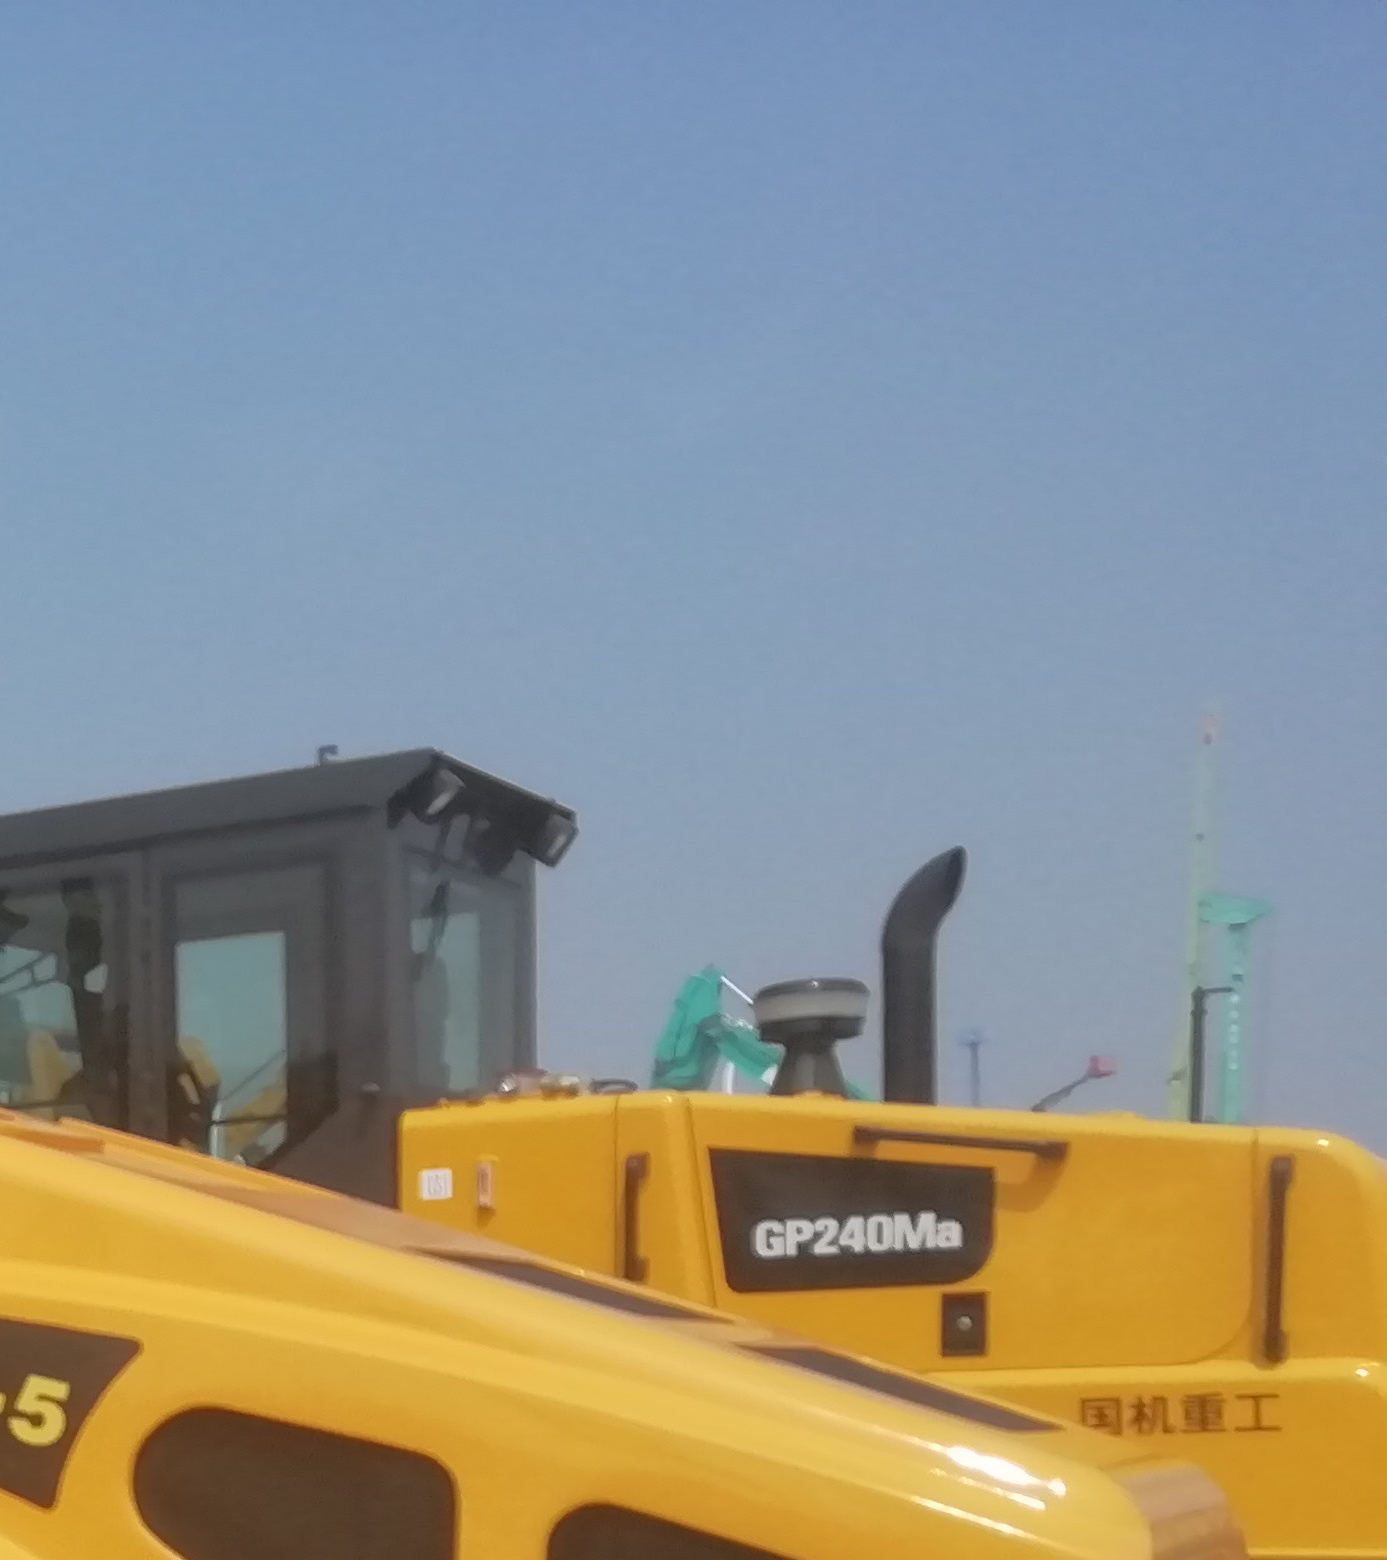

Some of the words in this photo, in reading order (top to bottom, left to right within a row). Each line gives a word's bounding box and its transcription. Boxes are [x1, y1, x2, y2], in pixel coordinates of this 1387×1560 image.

[754, 1210, 964, 1257] GP240Ma
[1080, 1392, 1282, 1436] 国机重工
